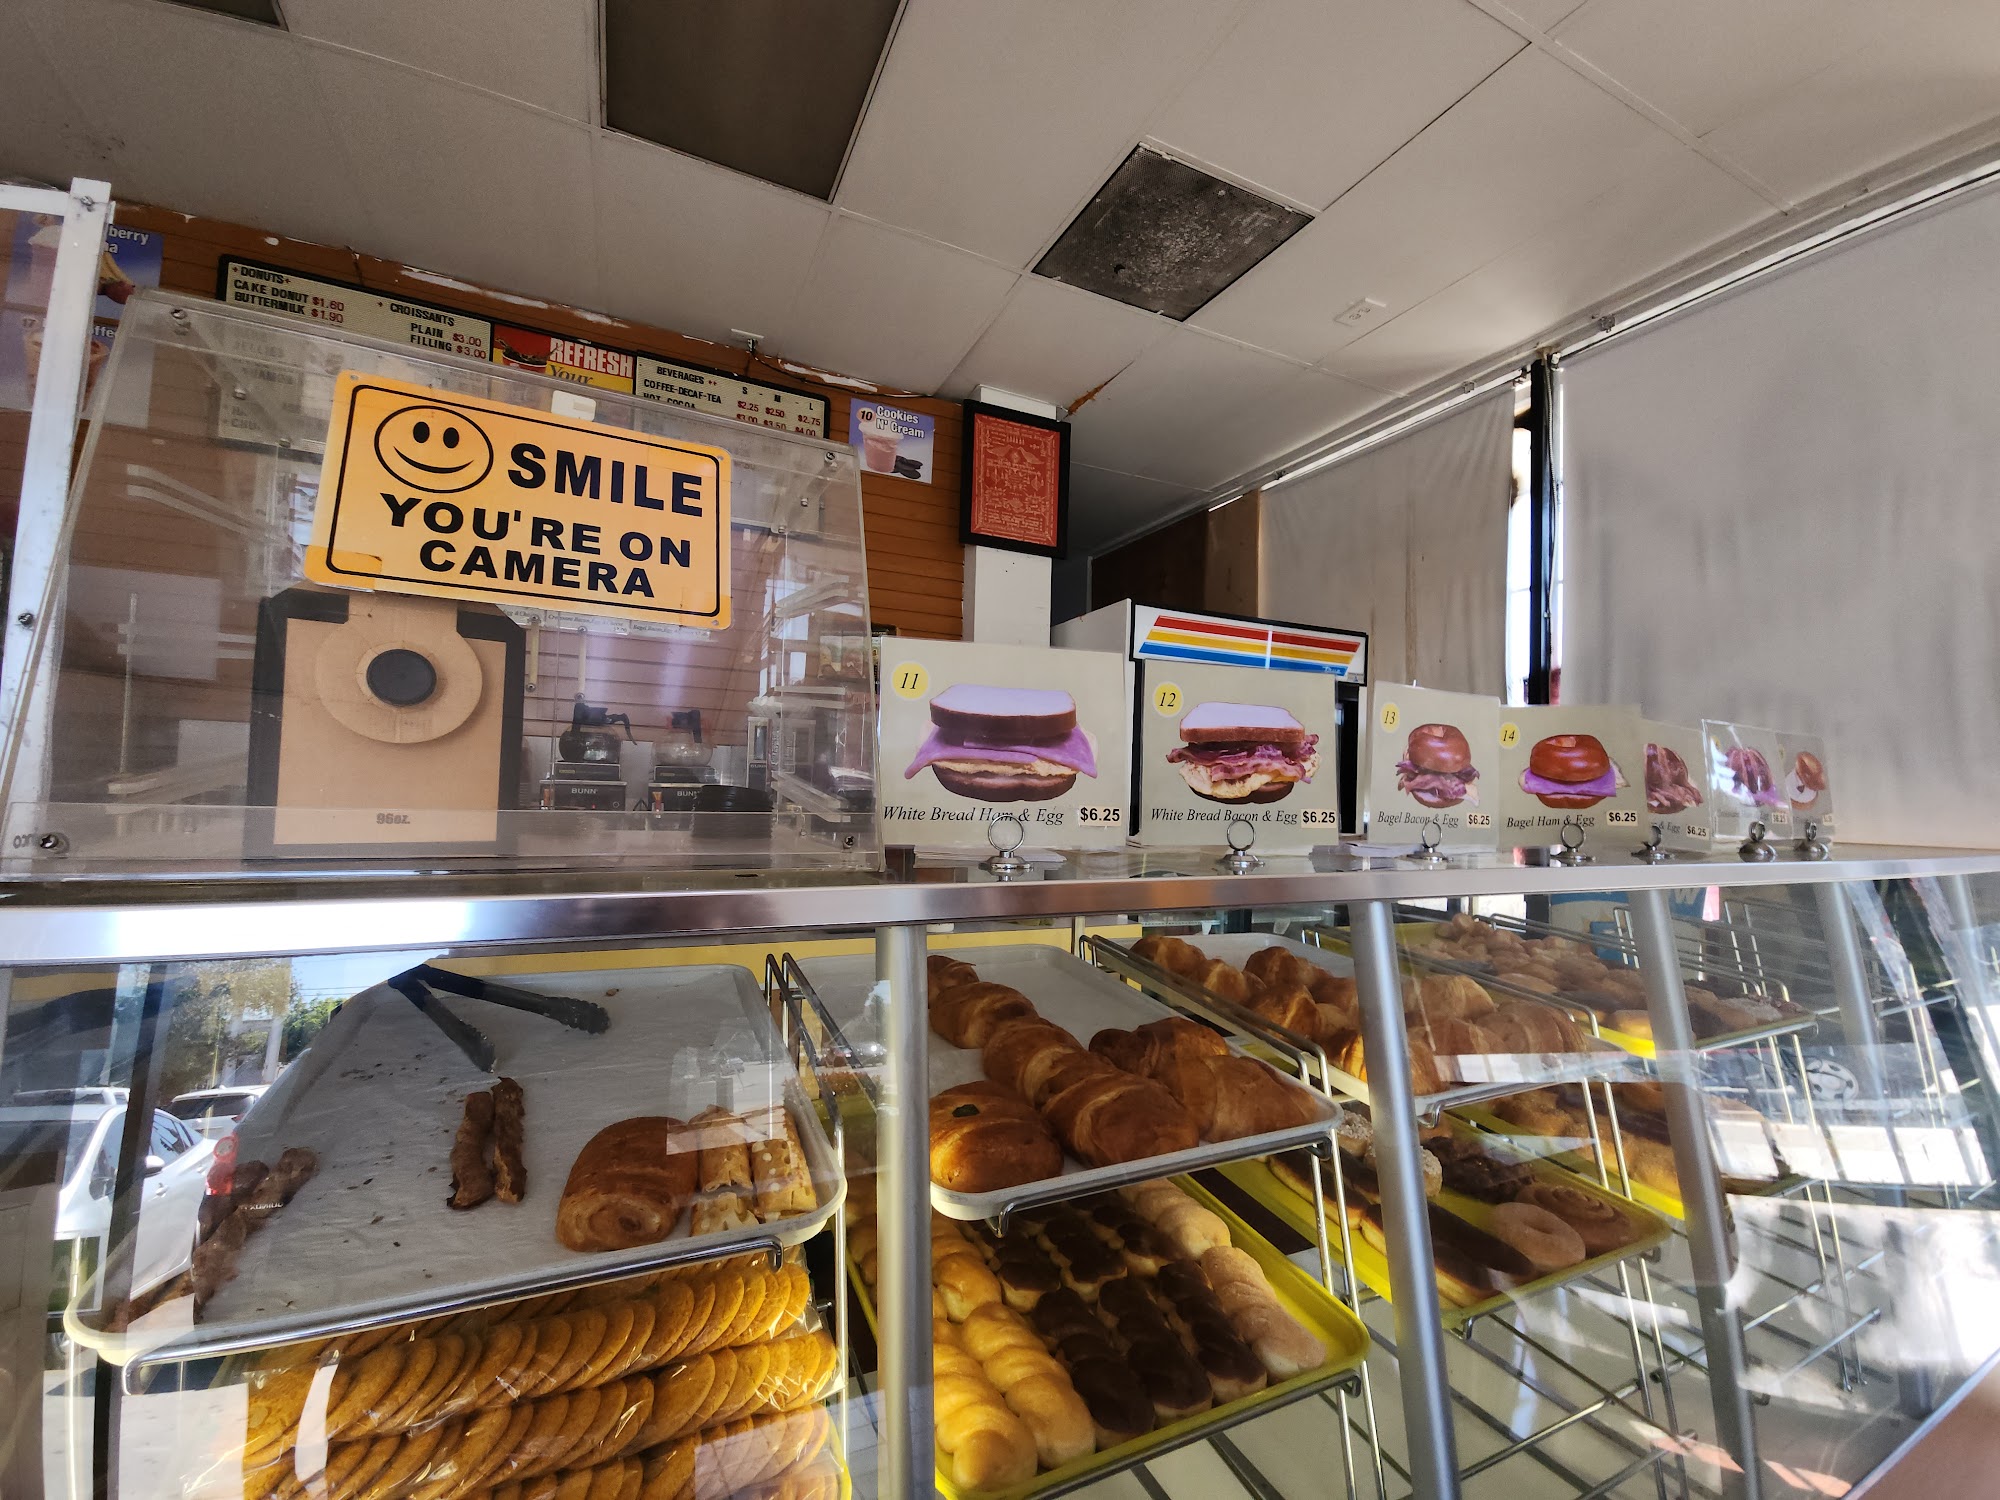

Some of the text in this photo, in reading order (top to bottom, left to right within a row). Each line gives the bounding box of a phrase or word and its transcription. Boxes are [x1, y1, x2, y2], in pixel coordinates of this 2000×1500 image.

[108, 224, 150, 246] berry
[240, 265, 284, 284] DONUTS
[233, 279, 345, 312] CAKE DONUT $1.60
[234, 291, 344, 324] BUTTERMILK $1.90
[389, 302, 455, 328] CROISSANTS
[93, 325, 116, 338] ffe
[410, 321, 482, 348] PLAIN $3.00
[410, 334, 487, 360] FILLING $3.00
[550, 337, 634, 379] REFRESH
[656, 365, 705, 386] BEVERAGES
[643, 378, 722, 405] COFFEE-DECAF-TEA
[736, 400, 760, 413] $2.25
[797, 414, 821, 427] $2.75
[859, 405, 920, 425] 10 Cookies
[876, 418, 925, 440] N' Cream
[507, 442, 703, 518] SMILE
[379, 492, 691, 568] YOU'RE ON
[419, 539, 655, 598] CAMERA
[899, 671, 919, 690] 11
[1158, 691, 1177, 708] 12
[1384, 710, 1397, 725] 13
[1503, 729, 1516, 743] 14
[571, 787, 597, 795] BUNN
[883, 804, 1121, 826] White Bread Ham & Egg $6.25
[1150, 808, 1336, 826] White Bread Bacon & Egg $6.25
[1377, 810, 1403, 827] Bagel
[1404, 811, 1431, 824] Bacon
[1442, 813, 1460, 829] Egg
[1468, 814, 1490, 826] $6.25
[1506, 816, 1535, 830] Bagel
[1537, 815, 1561, 826] Ham
[1575, 814, 1595, 828] Egg
[1608, 811, 1637, 823] $6.25
[1667, 822, 1681, 834] Egg
[1687, 825, 1707, 837] $6.25
